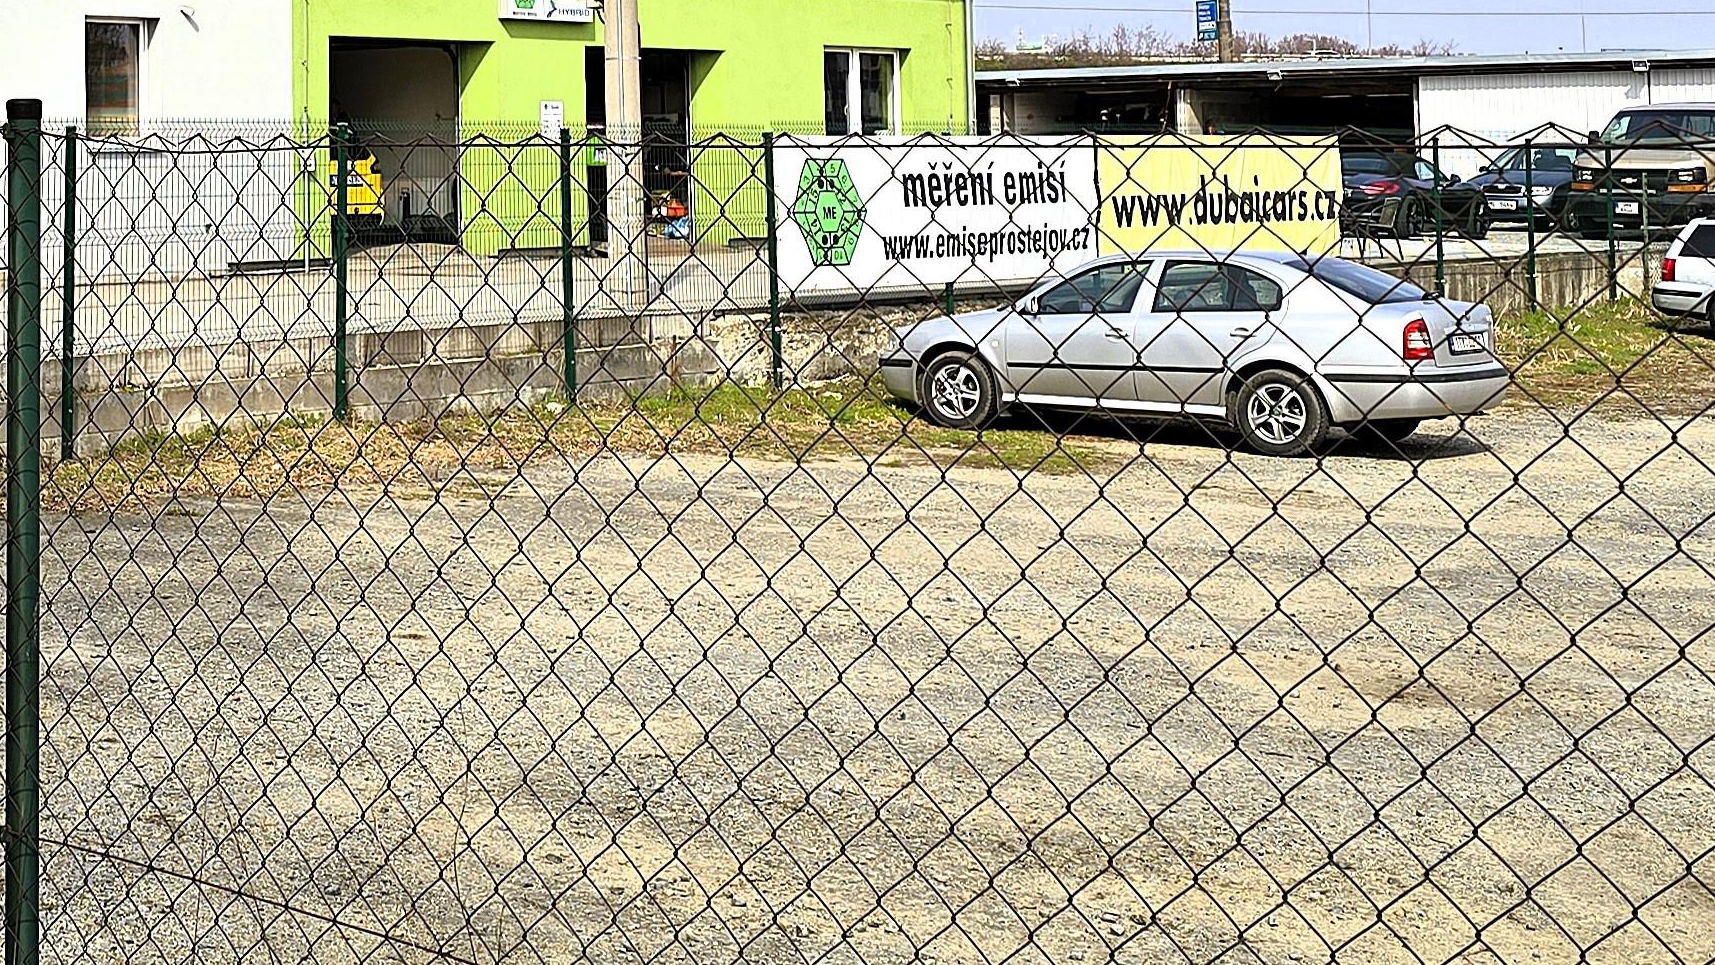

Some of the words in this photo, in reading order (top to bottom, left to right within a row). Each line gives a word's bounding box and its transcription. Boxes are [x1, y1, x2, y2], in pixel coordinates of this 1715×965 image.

[902, 161, 994, 207] měření
[1004, 160, 1067, 205] emisí
[1112, 174, 1337, 228] www.dubaicars.cz
[823, 206, 837, 220] ME
[883, 222, 1090, 263] www.emiseprostejov.cz
